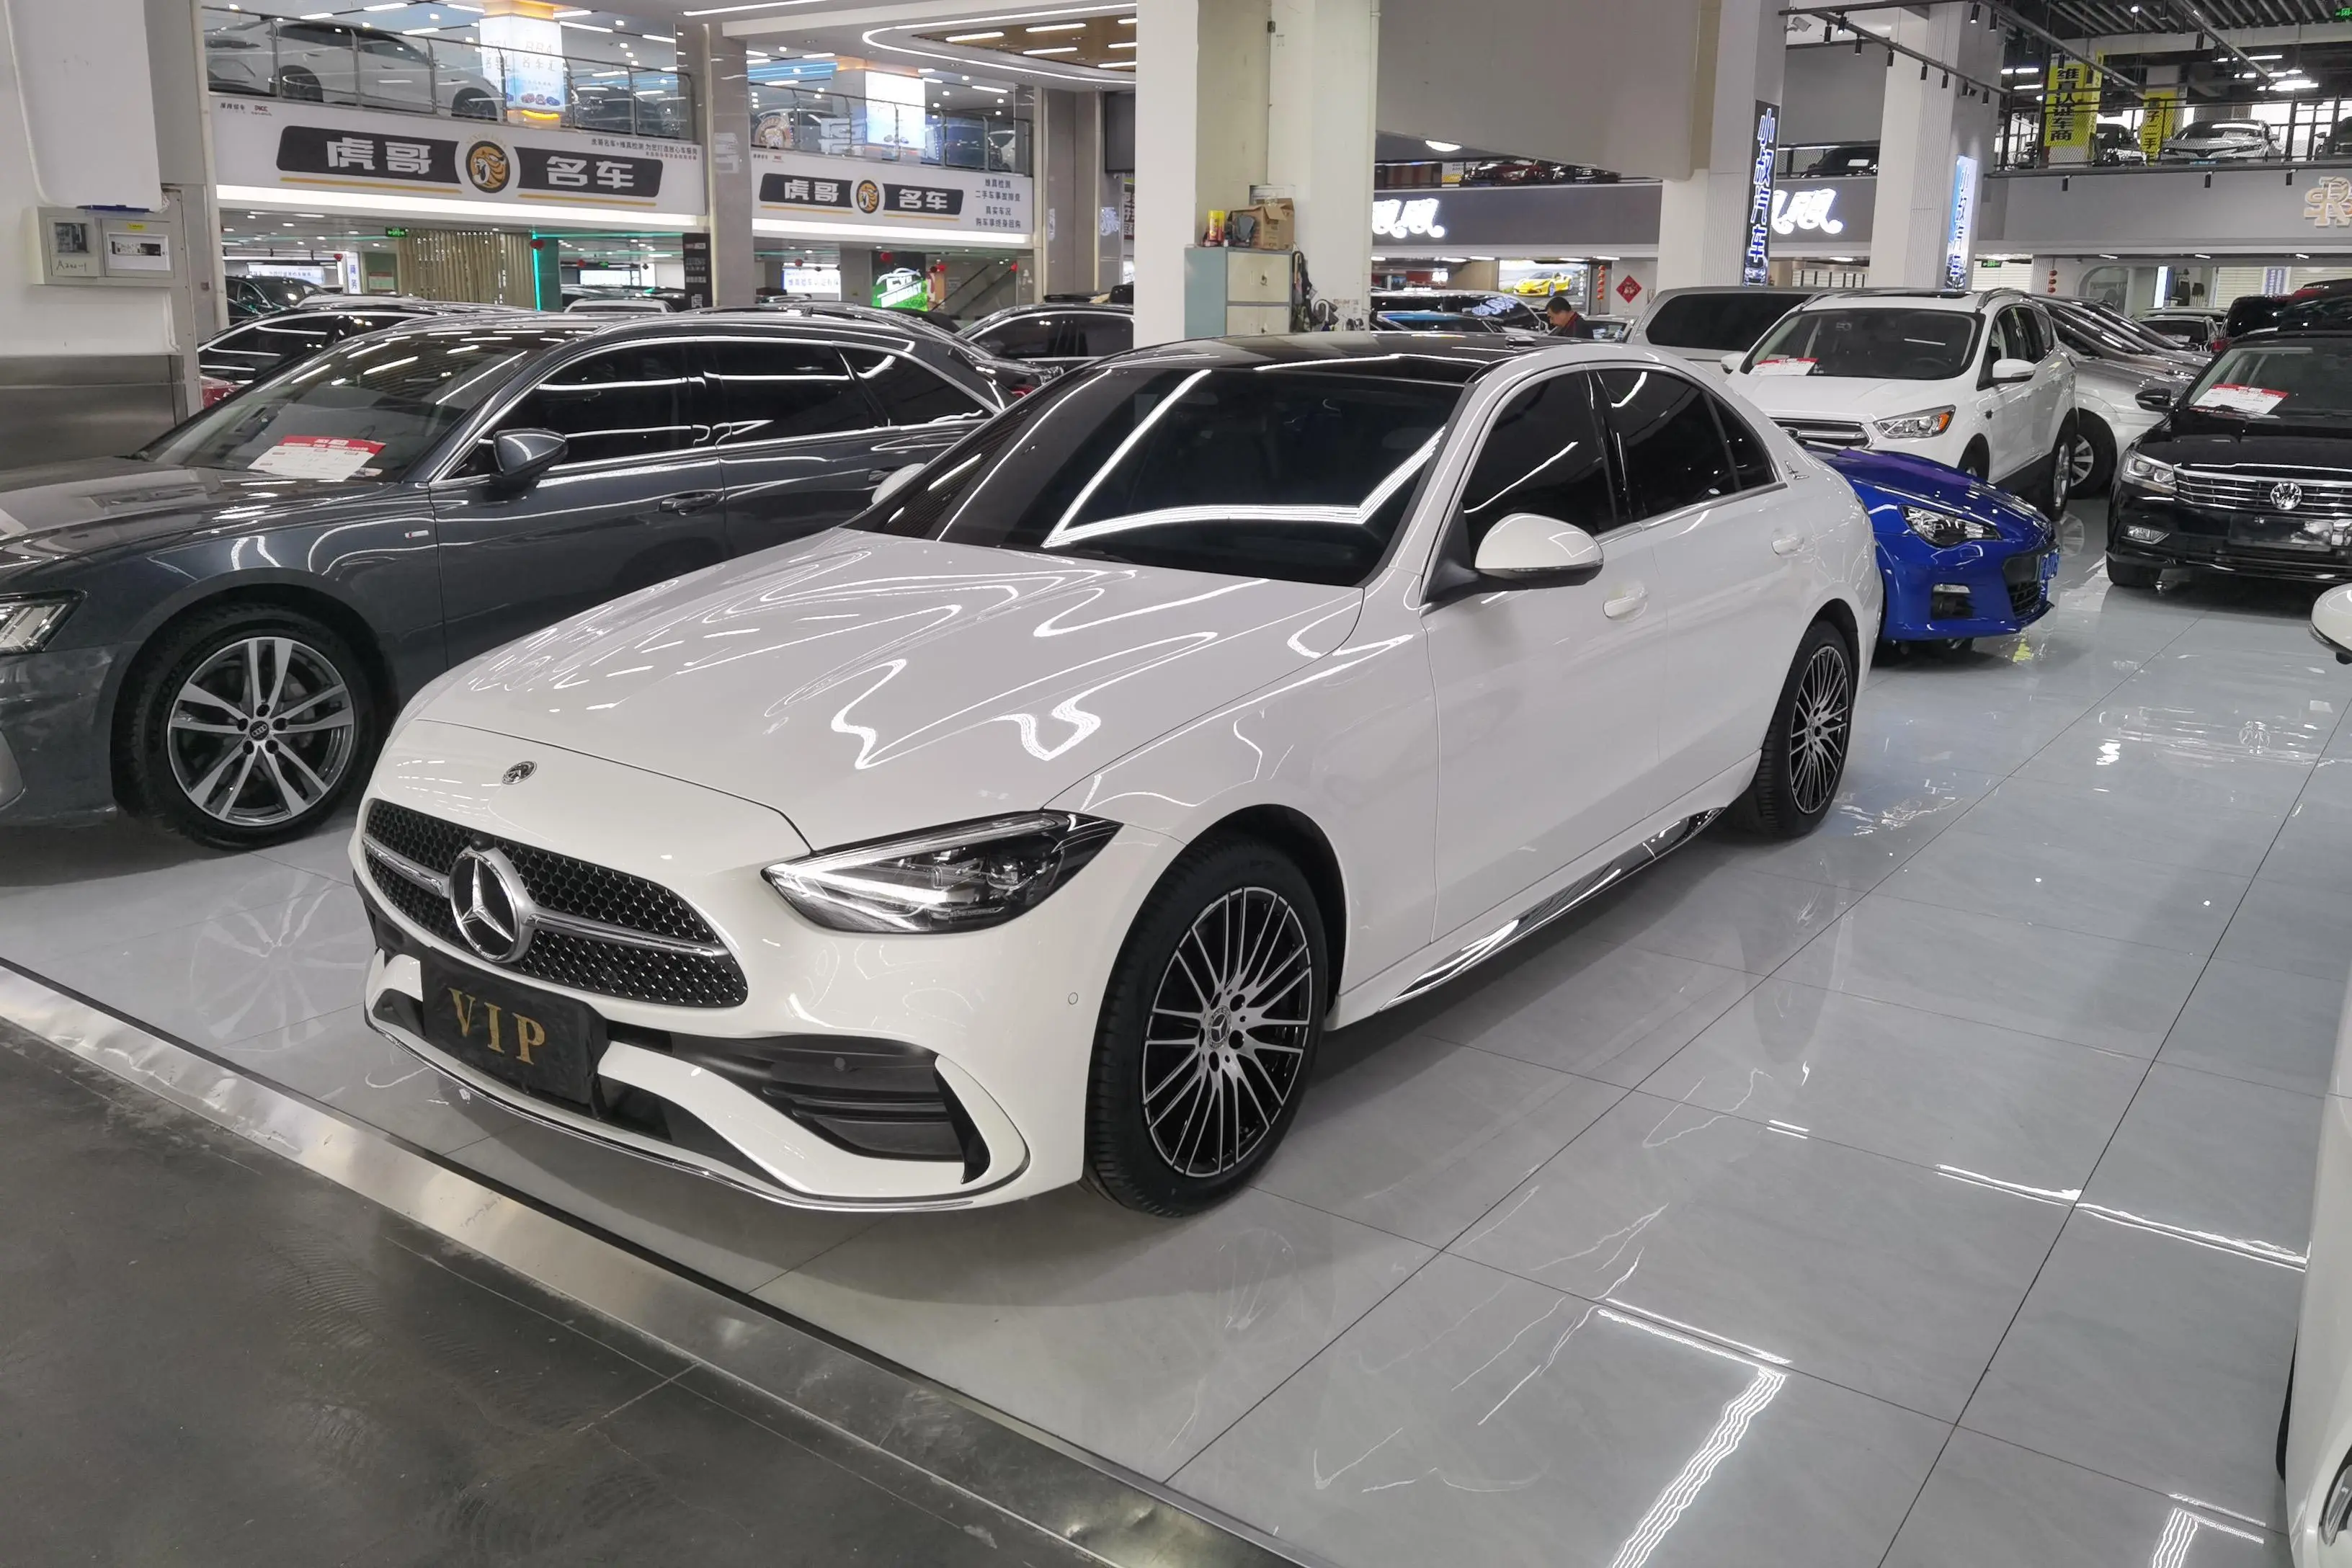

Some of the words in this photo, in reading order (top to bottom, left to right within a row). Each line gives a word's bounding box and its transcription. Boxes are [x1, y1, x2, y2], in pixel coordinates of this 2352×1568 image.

[326, 137, 432, 174] 虎哥
[546, 156, 635, 189] 名车
[784, 179, 839, 202] 虎哥
[899, 189, 948, 210] 名车
[448, 988, 545, 1065] VIP
